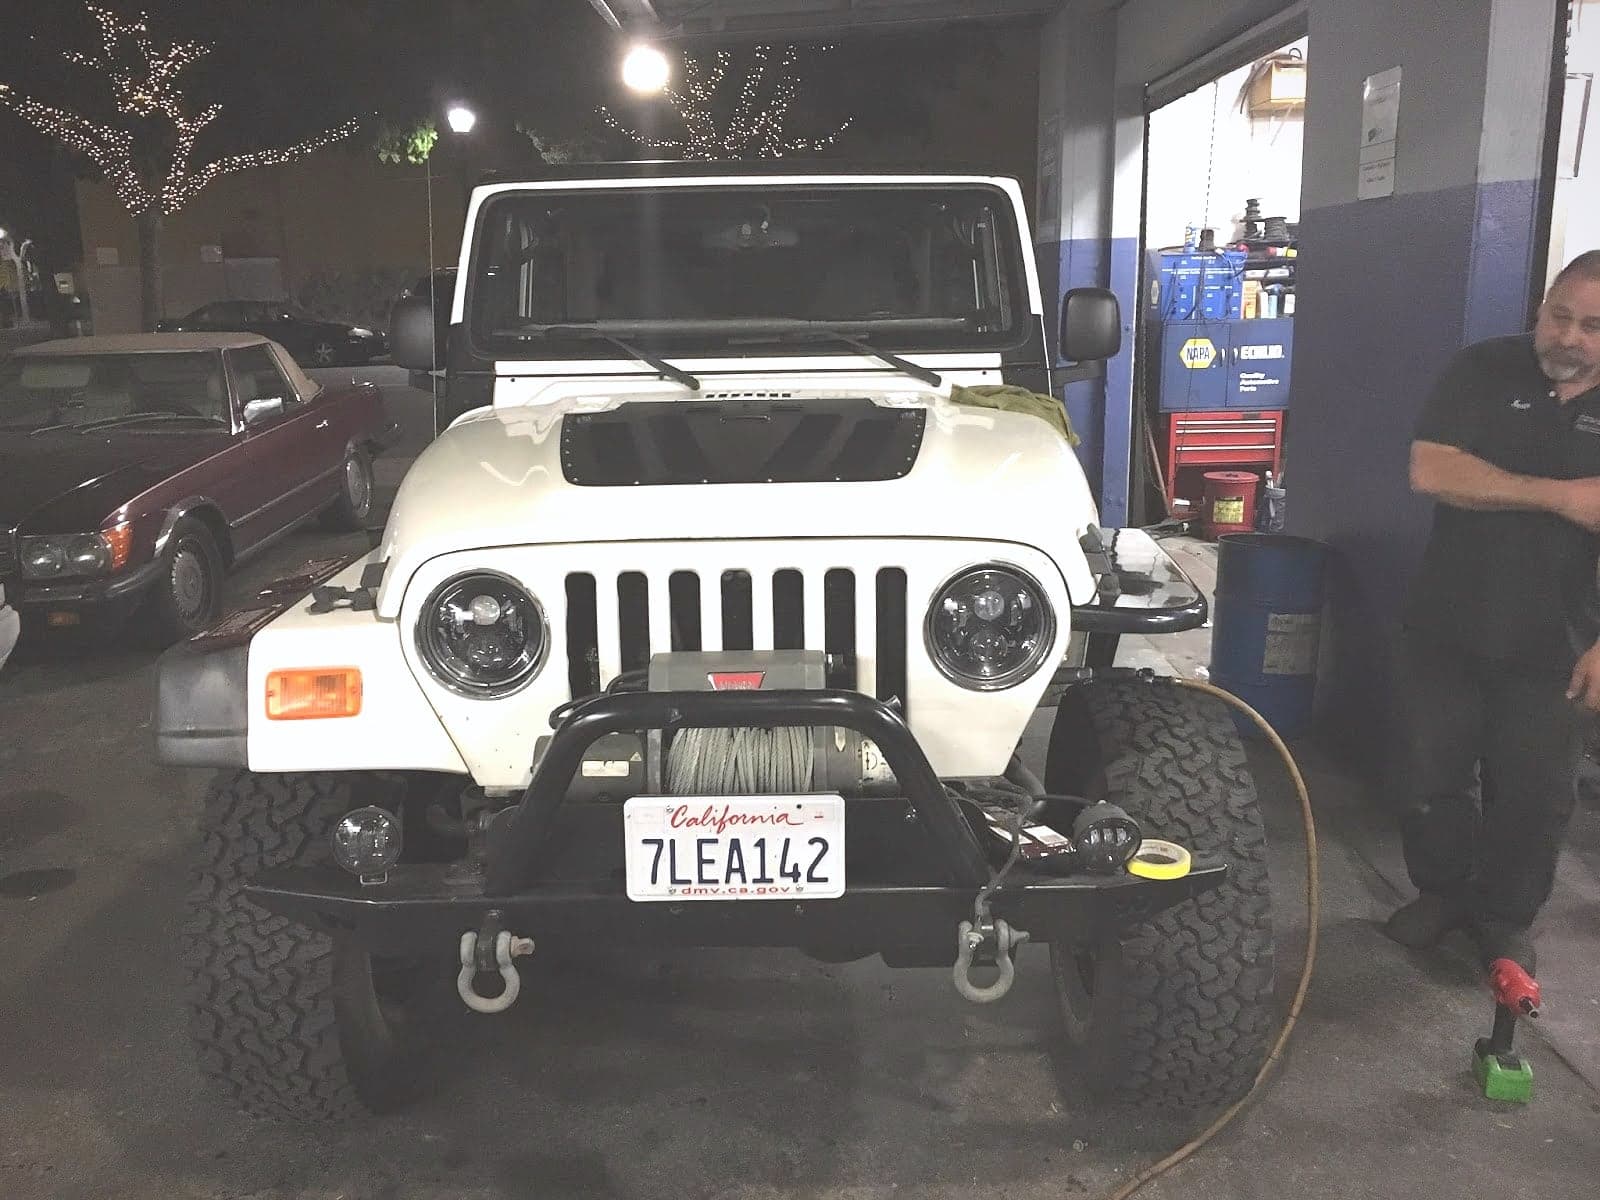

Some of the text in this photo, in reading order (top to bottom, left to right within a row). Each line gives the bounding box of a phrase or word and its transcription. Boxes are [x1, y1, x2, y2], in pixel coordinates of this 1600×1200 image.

[1187, 347, 1209, 360] NAPA
[671, 804, 804, 834] California
[641, 836, 830, 885] 7LEA142
[681, 885, 791, 896] dmv.ca.gov
